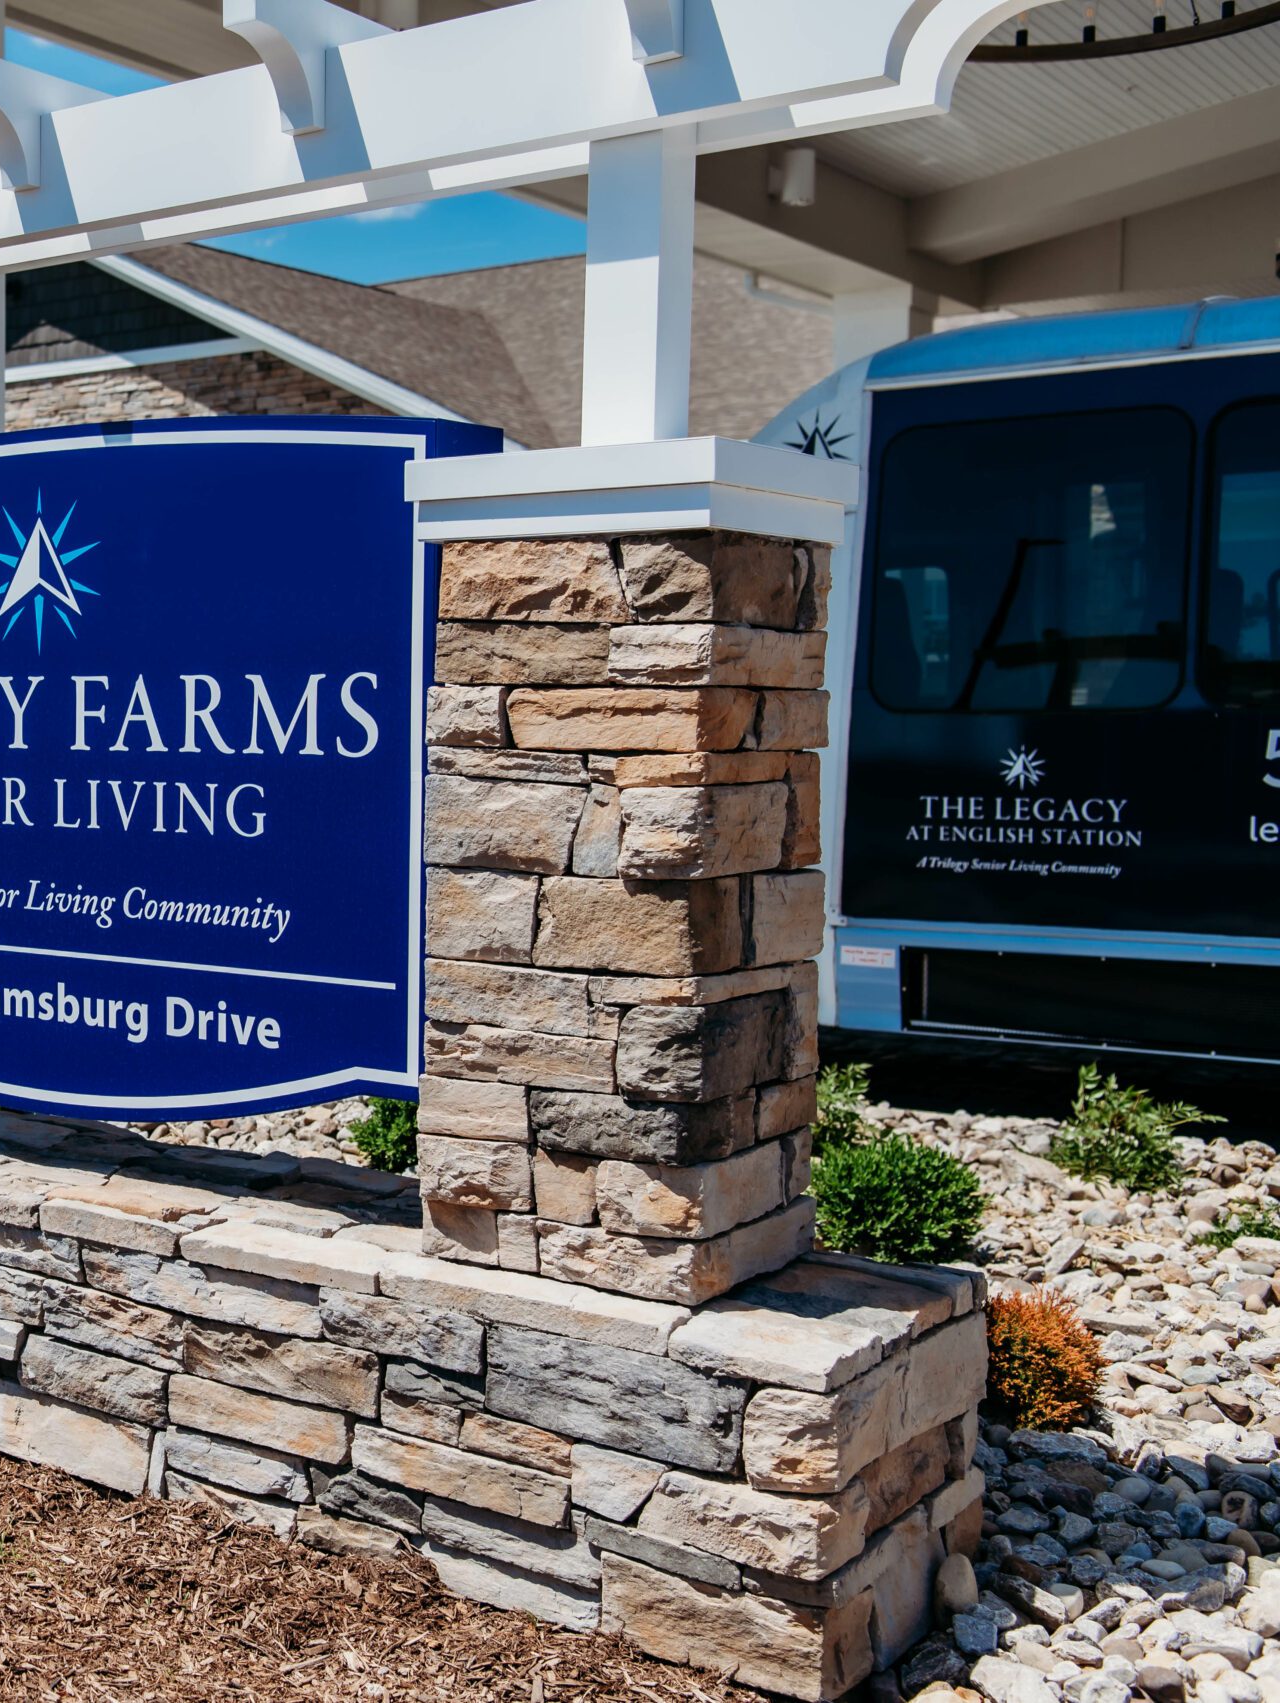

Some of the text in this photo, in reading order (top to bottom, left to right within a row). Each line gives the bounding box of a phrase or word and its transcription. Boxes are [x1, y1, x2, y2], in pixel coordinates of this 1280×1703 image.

[70, 671, 380, 758] FARMS
[53, 778, 267, 838] LIVING
[920, 796, 1127, 823] THE LEGACY
[906, 825, 1142, 847] AT ENGLISH STATION
[917, 856, 1121, 877] A Trilogy Senior Living Community
[23, 879, 116, 929] Living
[122, 886, 291, 944] Community
[166, 996, 281, 1050] Drive
